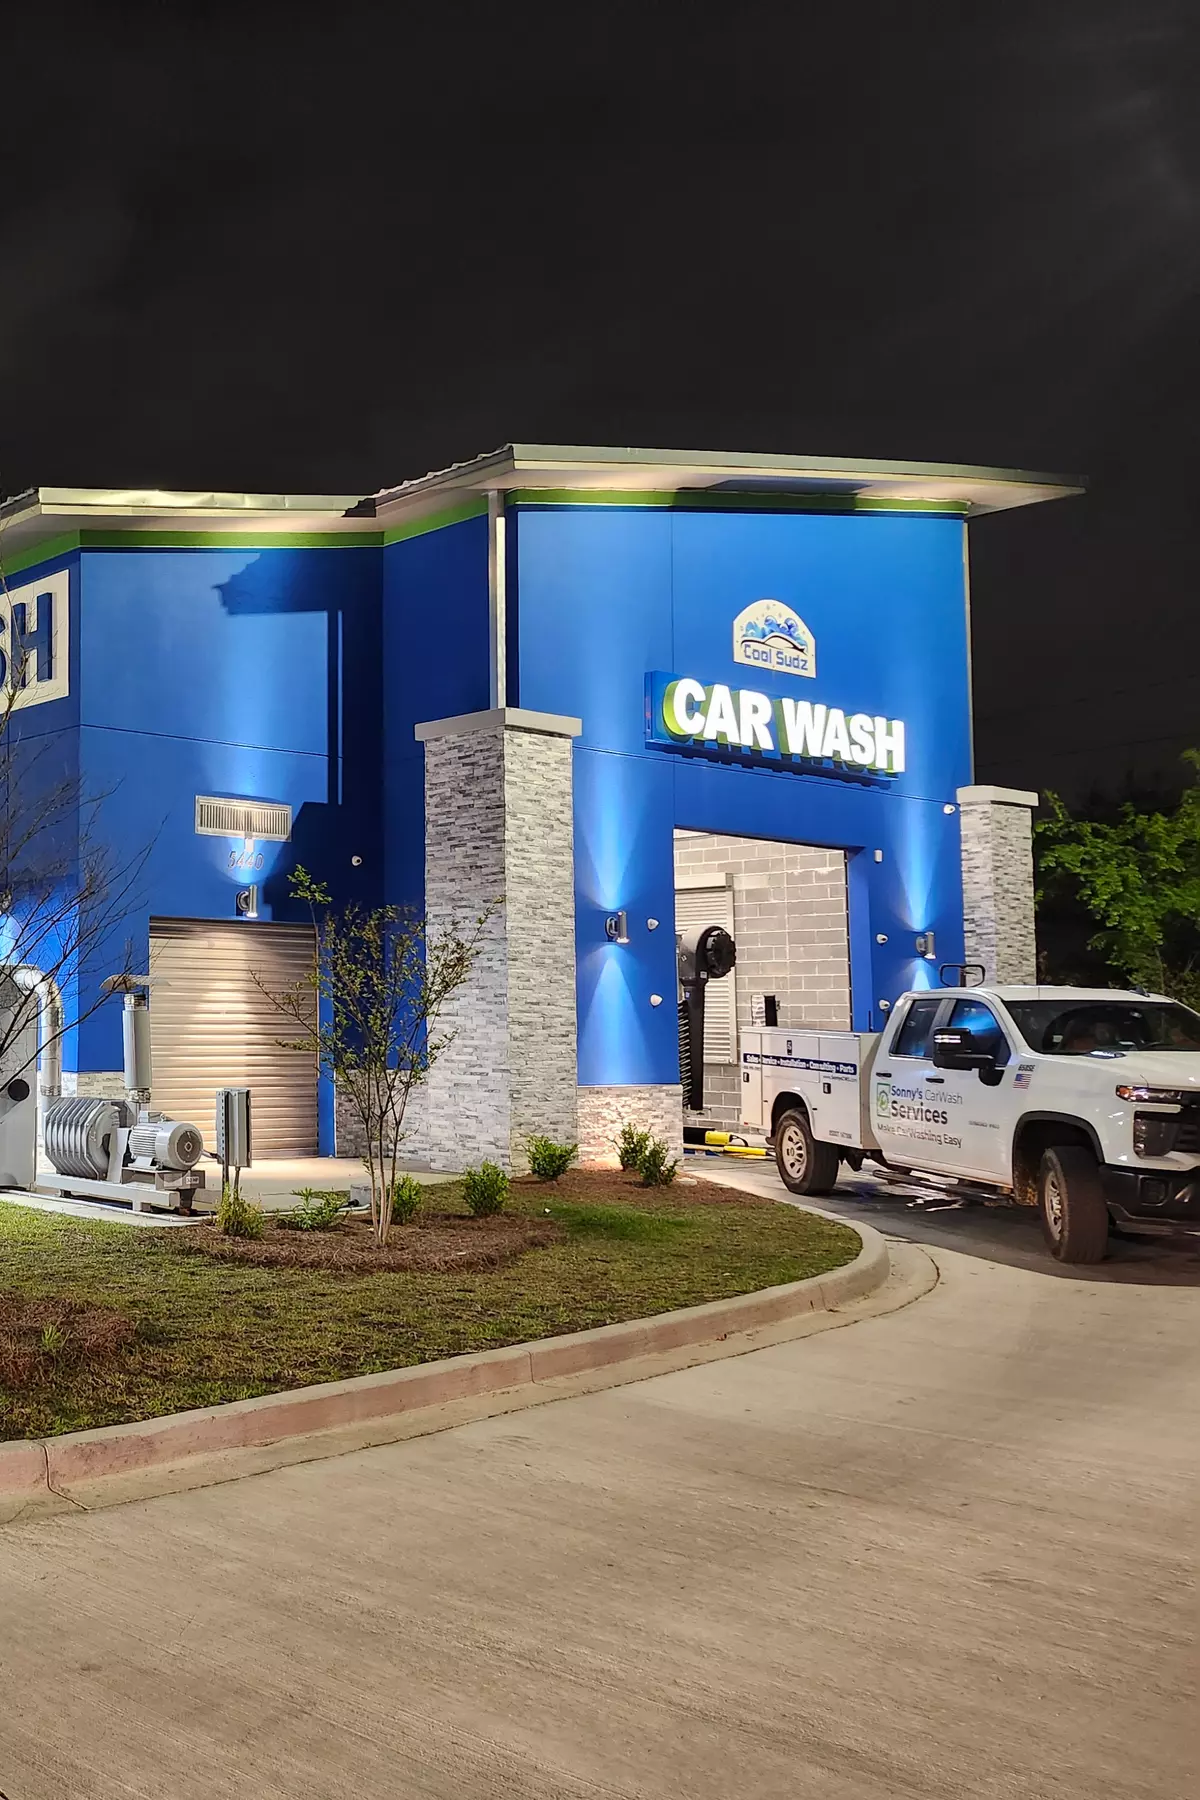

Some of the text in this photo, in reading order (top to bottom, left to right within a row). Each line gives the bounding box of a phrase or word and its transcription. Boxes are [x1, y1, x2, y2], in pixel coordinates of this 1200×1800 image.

[743, 643, 809, 671] Cool Sudz
[663, 678, 906, 773] CAR WASH
[227, 850, 265, 871] 5440
[891, 1085, 963, 1105] Sonny's CarWash
[890, 1100, 948, 1125] Services
[896, 1126, 943, 1146] CarWashing
[943, 1133, 962, 1148] Easy
